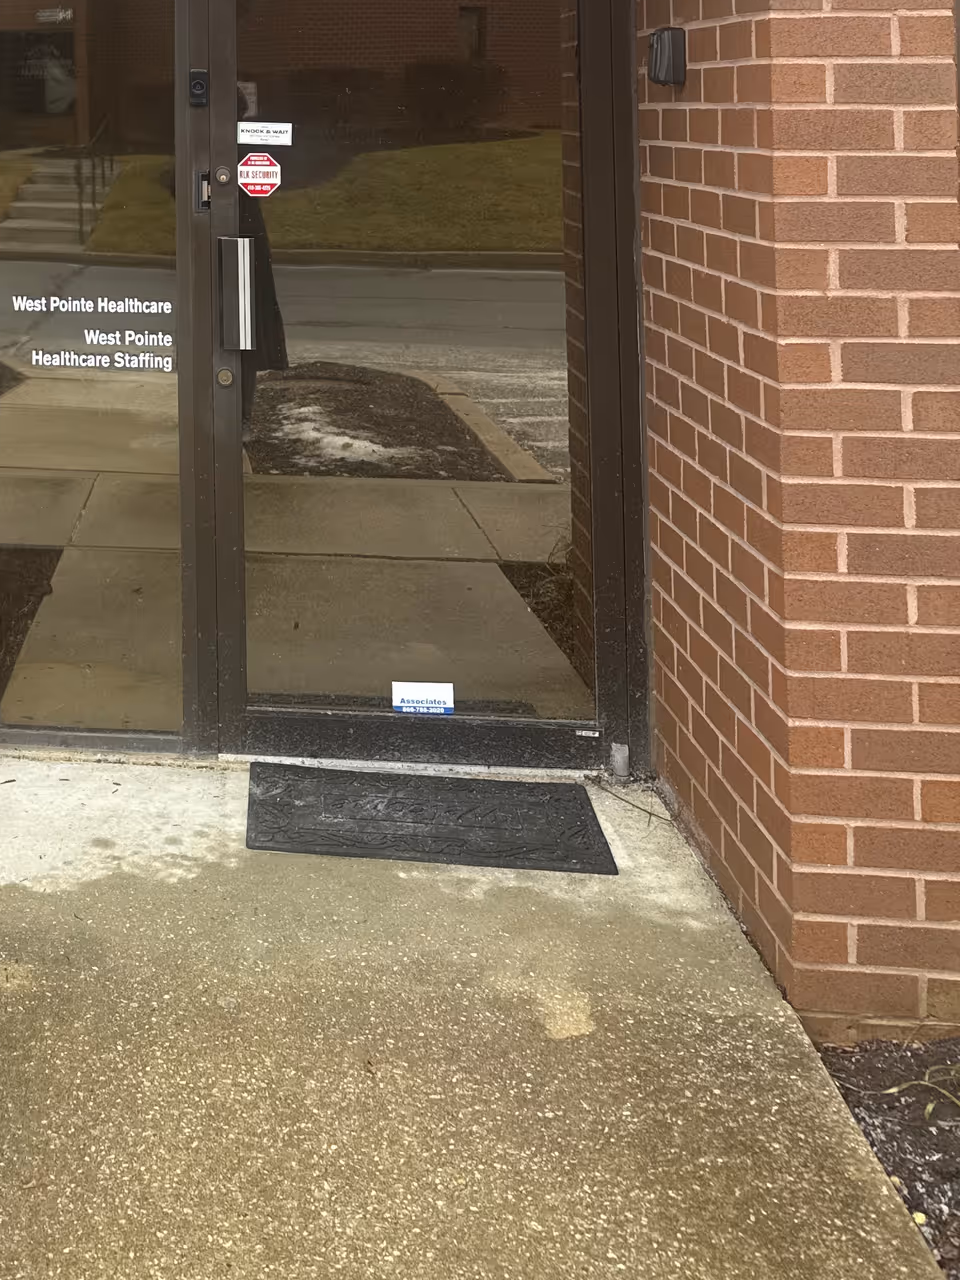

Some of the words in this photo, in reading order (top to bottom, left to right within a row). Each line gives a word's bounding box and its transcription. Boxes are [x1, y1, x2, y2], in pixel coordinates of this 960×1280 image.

[251, 171, 279, 179] SECURITY
[12, 295, 47, 312] West
[49, 296, 95, 313] Pointe
[97, 297, 173, 314] Healthcare
[84, 329, 122, 346] West
[125, 330, 173, 347] Pointe
[31, 350, 111, 368] Healthcare
[113, 351, 173, 372] Staffing
[400, 697, 447, 706] Associates
